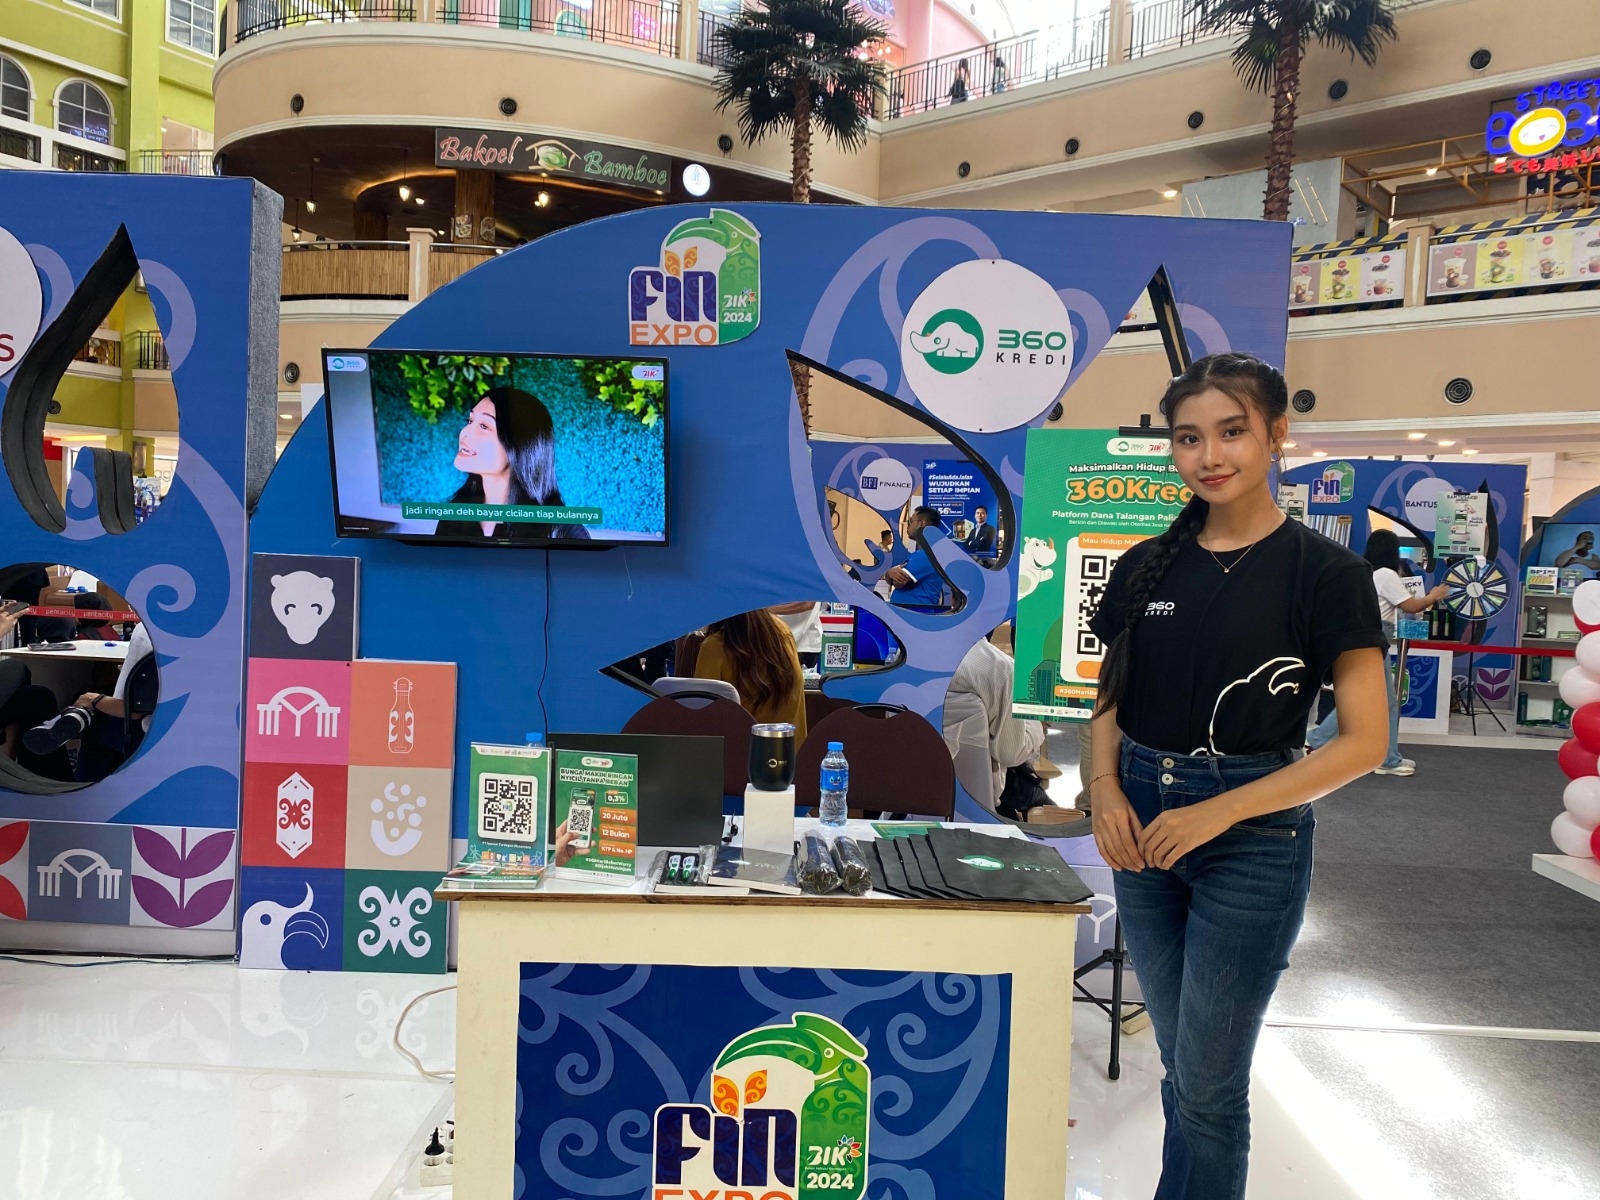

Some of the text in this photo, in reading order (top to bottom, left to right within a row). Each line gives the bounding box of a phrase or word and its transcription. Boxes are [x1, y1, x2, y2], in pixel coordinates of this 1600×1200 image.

[440, 134, 667, 186] Bakoel Bamboe
[723, 312, 752, 323] 2024
[631, 323, 717, 345] EXPO
[997, 329, 1067, 351] 360
[996, 352, 1066, 365] KREDI
[1069, 463, 1134, 473] Maksimalkan
[1136, 463, 1166, 473] Hidup
[862, 477, 912, 489] BFI FINANCE
[1406, 500, 1438, 509] BANTUS
[405, 506, 599, 521] jadi ringan deh bayar cicilan tiap bulannya
[1052, 510, 1089, 518] Platform
[1091, 511, 1114, 519] Dana
[1115, 512, 1155, 522] Talangan
[1100, 538, 1123, 546] Hidup
[1146, 601, 1175, 611] 360
[45, 608, 76, 617] pentacity
[83, 611, 114, 619] pentacity
[560, 774, 581, 782] NYICIL
[582, 776, 605, 784] TANPA
[584, 770, 606, 778] MAKIN
[606, 772, 633, 780] RINGAN
[607, 795, 626, 803] 0,3%
[611, 814, 628, 822] Juta
[609, 830, 630, 839] Bulan
[806, 1172, 855, 1190] 2024
